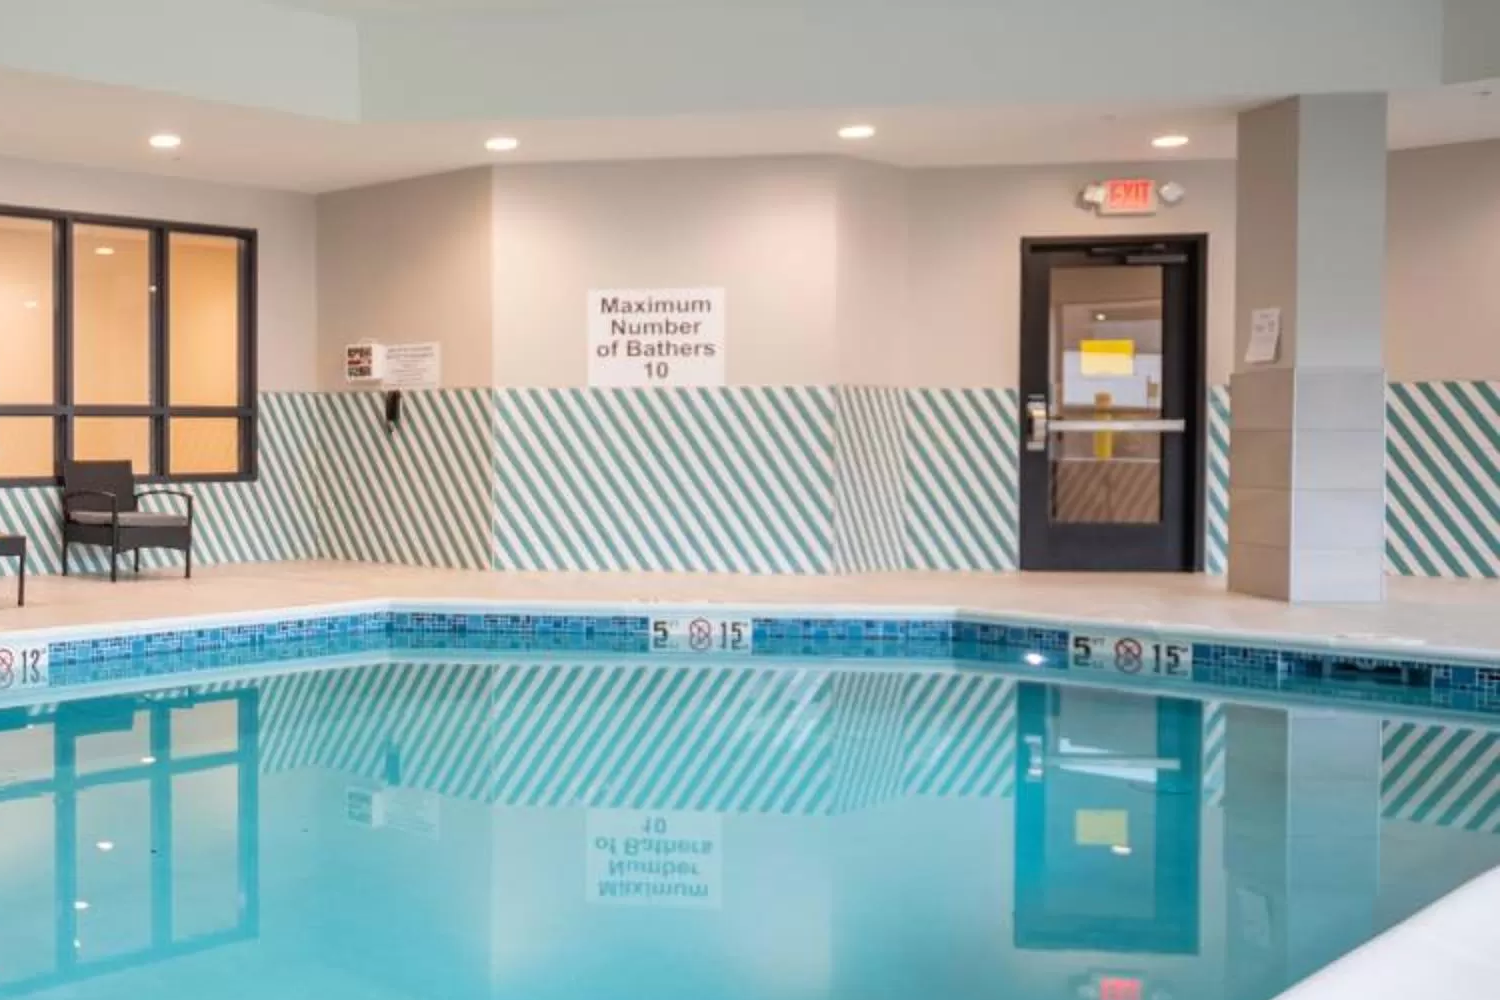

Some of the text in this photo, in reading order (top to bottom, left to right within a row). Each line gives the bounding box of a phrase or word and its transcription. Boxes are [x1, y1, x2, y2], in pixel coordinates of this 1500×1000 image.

[1109, 182, 1149, 207] EXIT
[600, 296, 711, 314] Maximum
[611, 317, 702, 335] Number
[596, 339, 716, 358] of Bathers
[644, 362, 669, 379] 10
